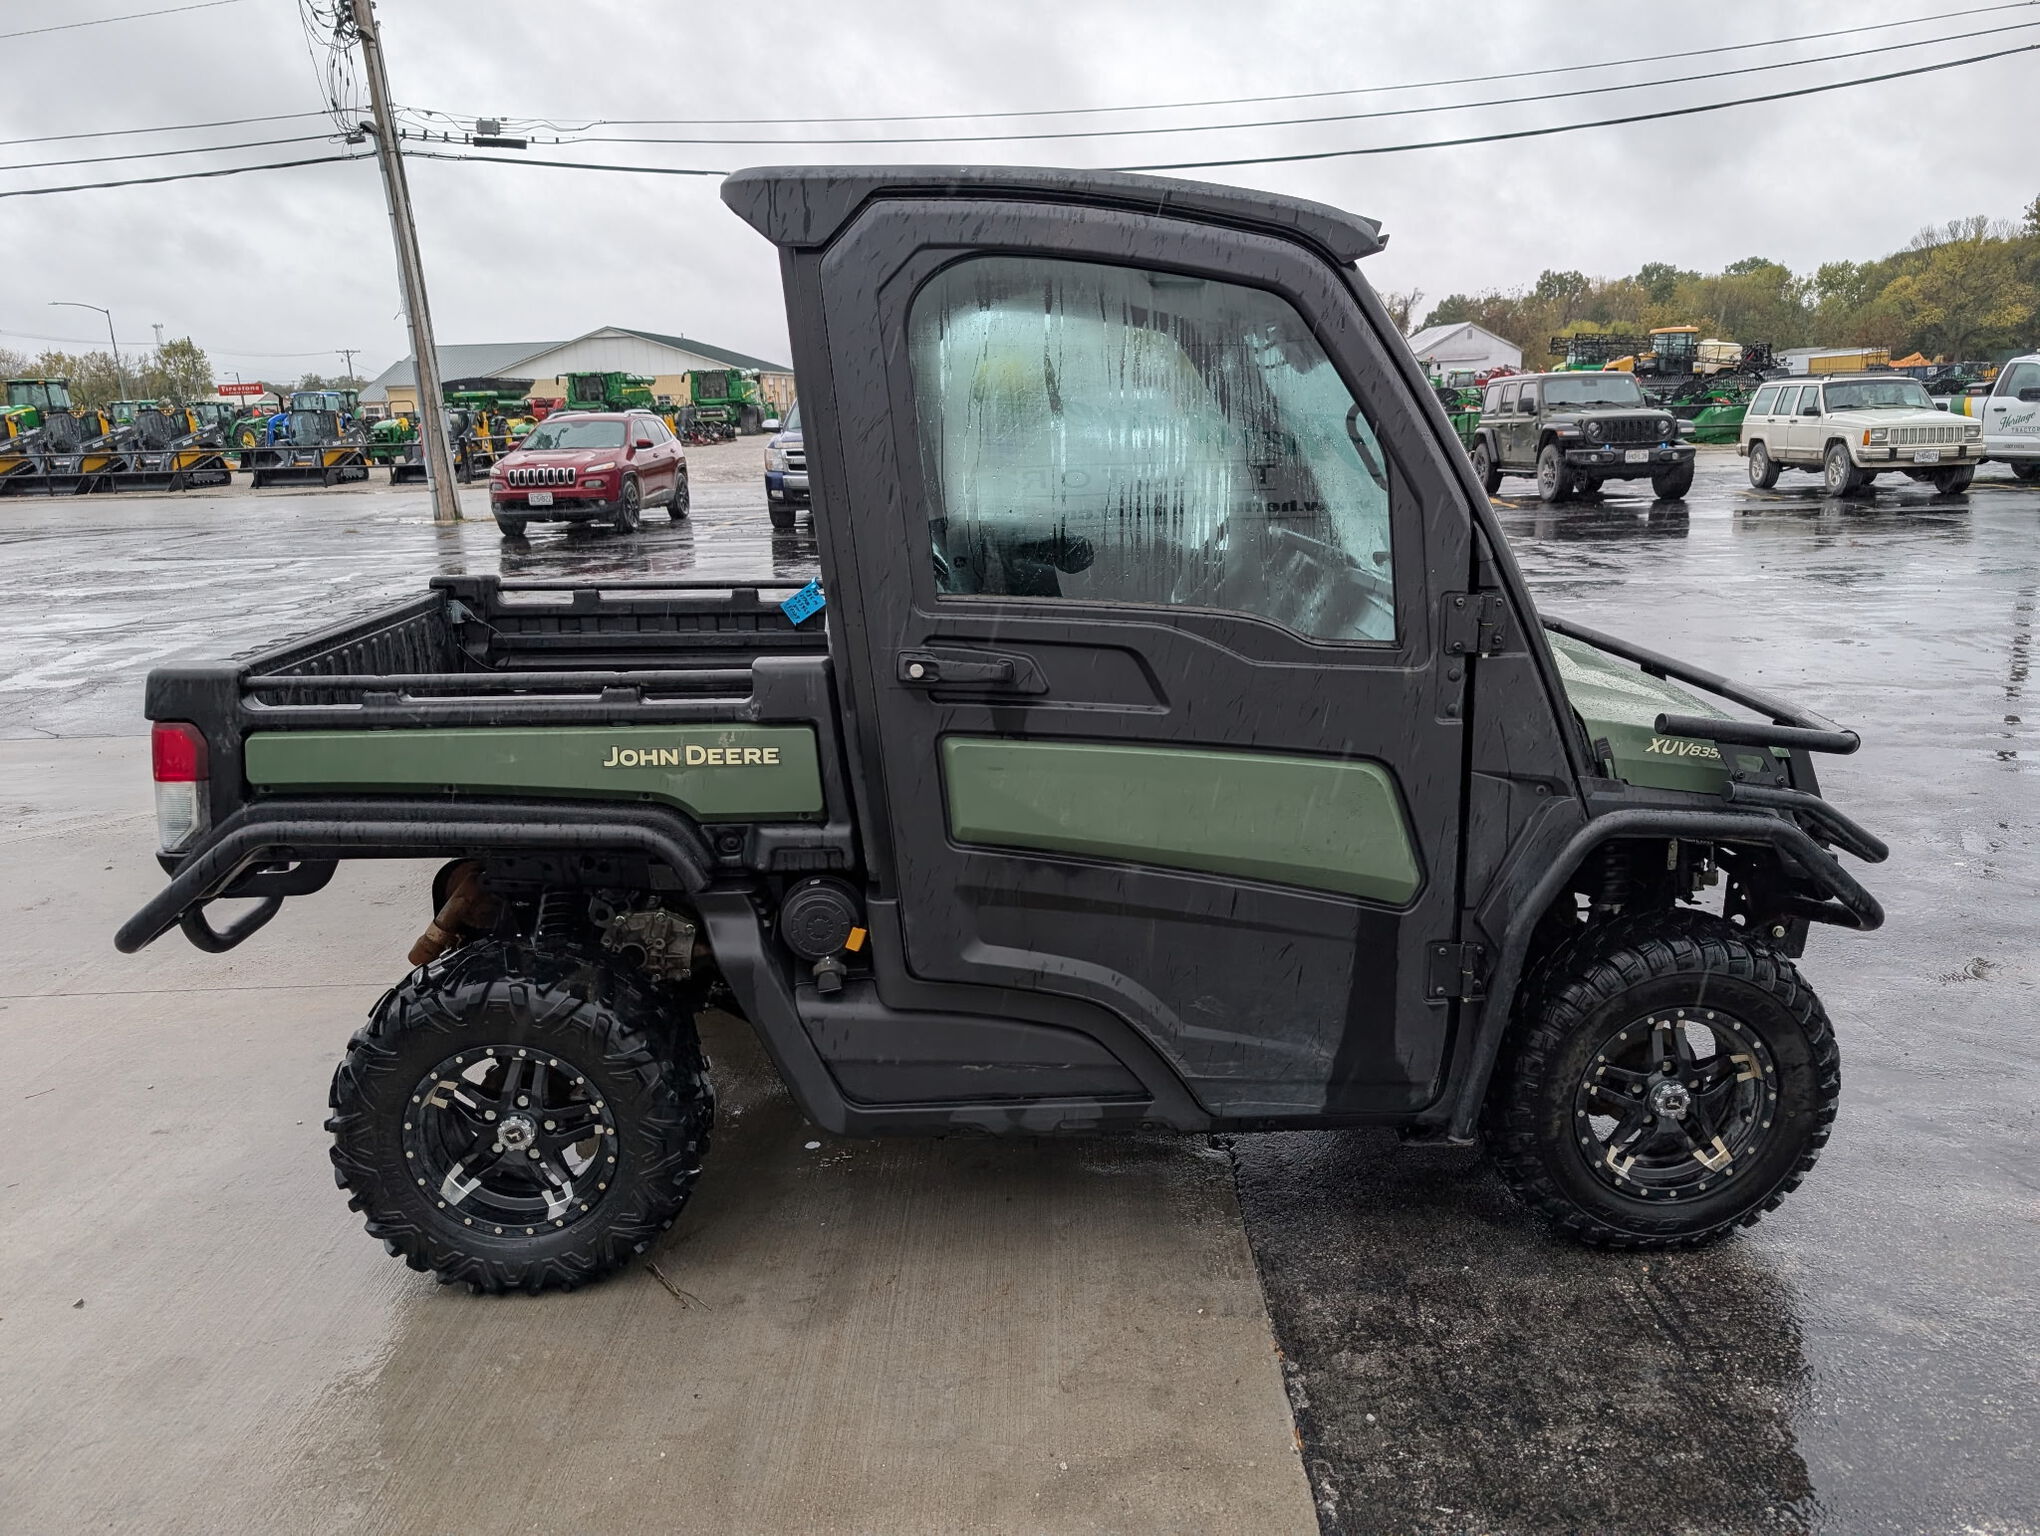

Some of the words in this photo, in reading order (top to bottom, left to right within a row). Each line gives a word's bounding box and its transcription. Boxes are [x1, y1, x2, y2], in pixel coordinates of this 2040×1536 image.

[1999, 412, 2036, 432] Heritage
[603, 746, 679, 767] JOHN
[685, 745, 780, 766] DEERE
